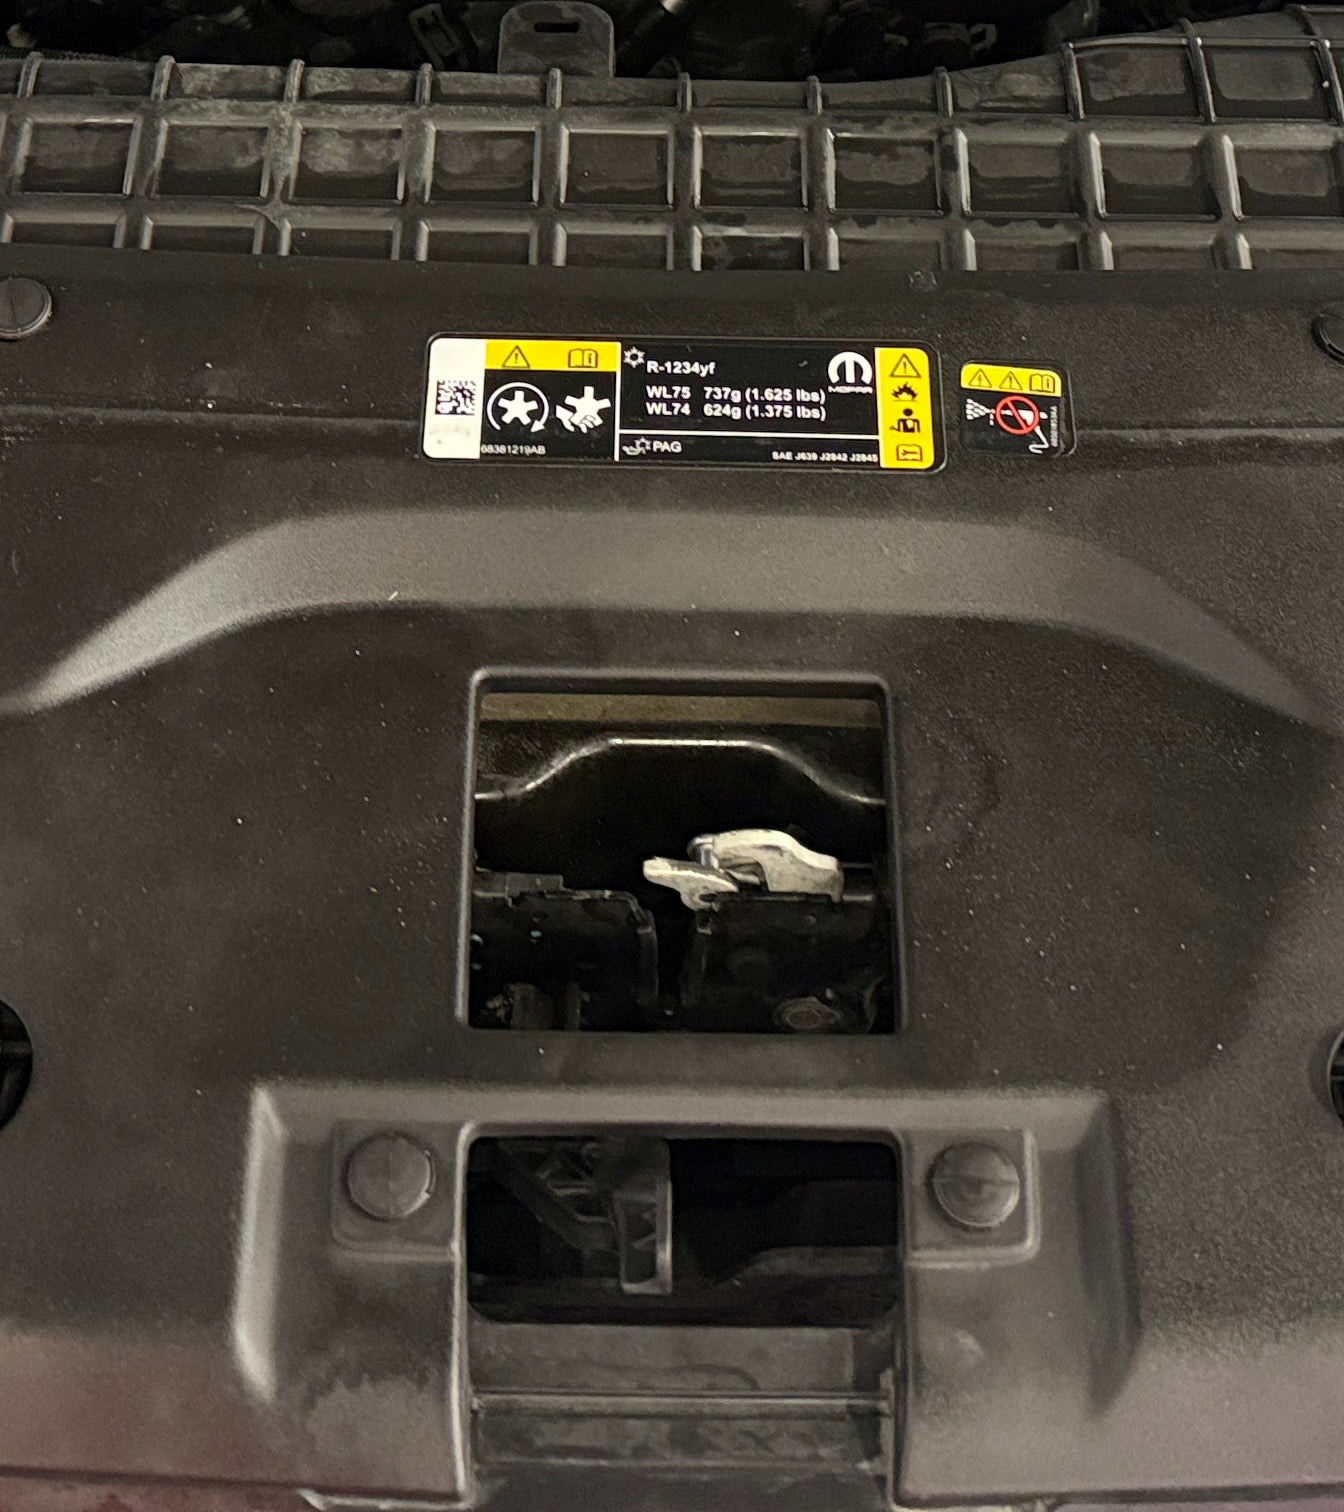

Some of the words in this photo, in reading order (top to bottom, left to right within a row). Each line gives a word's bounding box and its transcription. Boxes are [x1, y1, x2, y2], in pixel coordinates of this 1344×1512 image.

[646, 360, 716, 378] R-1234yf
[645, 385, 692, 399] WL75
[703, 386, 742, 403] 737g
[744, 387, 793, 404] (1.625
[795, 388, 826, 405] lbs)
[645, 402, 692, 416] WL74
[703, 402, 742, 420] 624g
[744, 404, 793, 420] (1.375
[795, 405, 827, 422] lbs)
[652, 440, 683, 453] PAG
[771, 450, 793, 461] SAE
